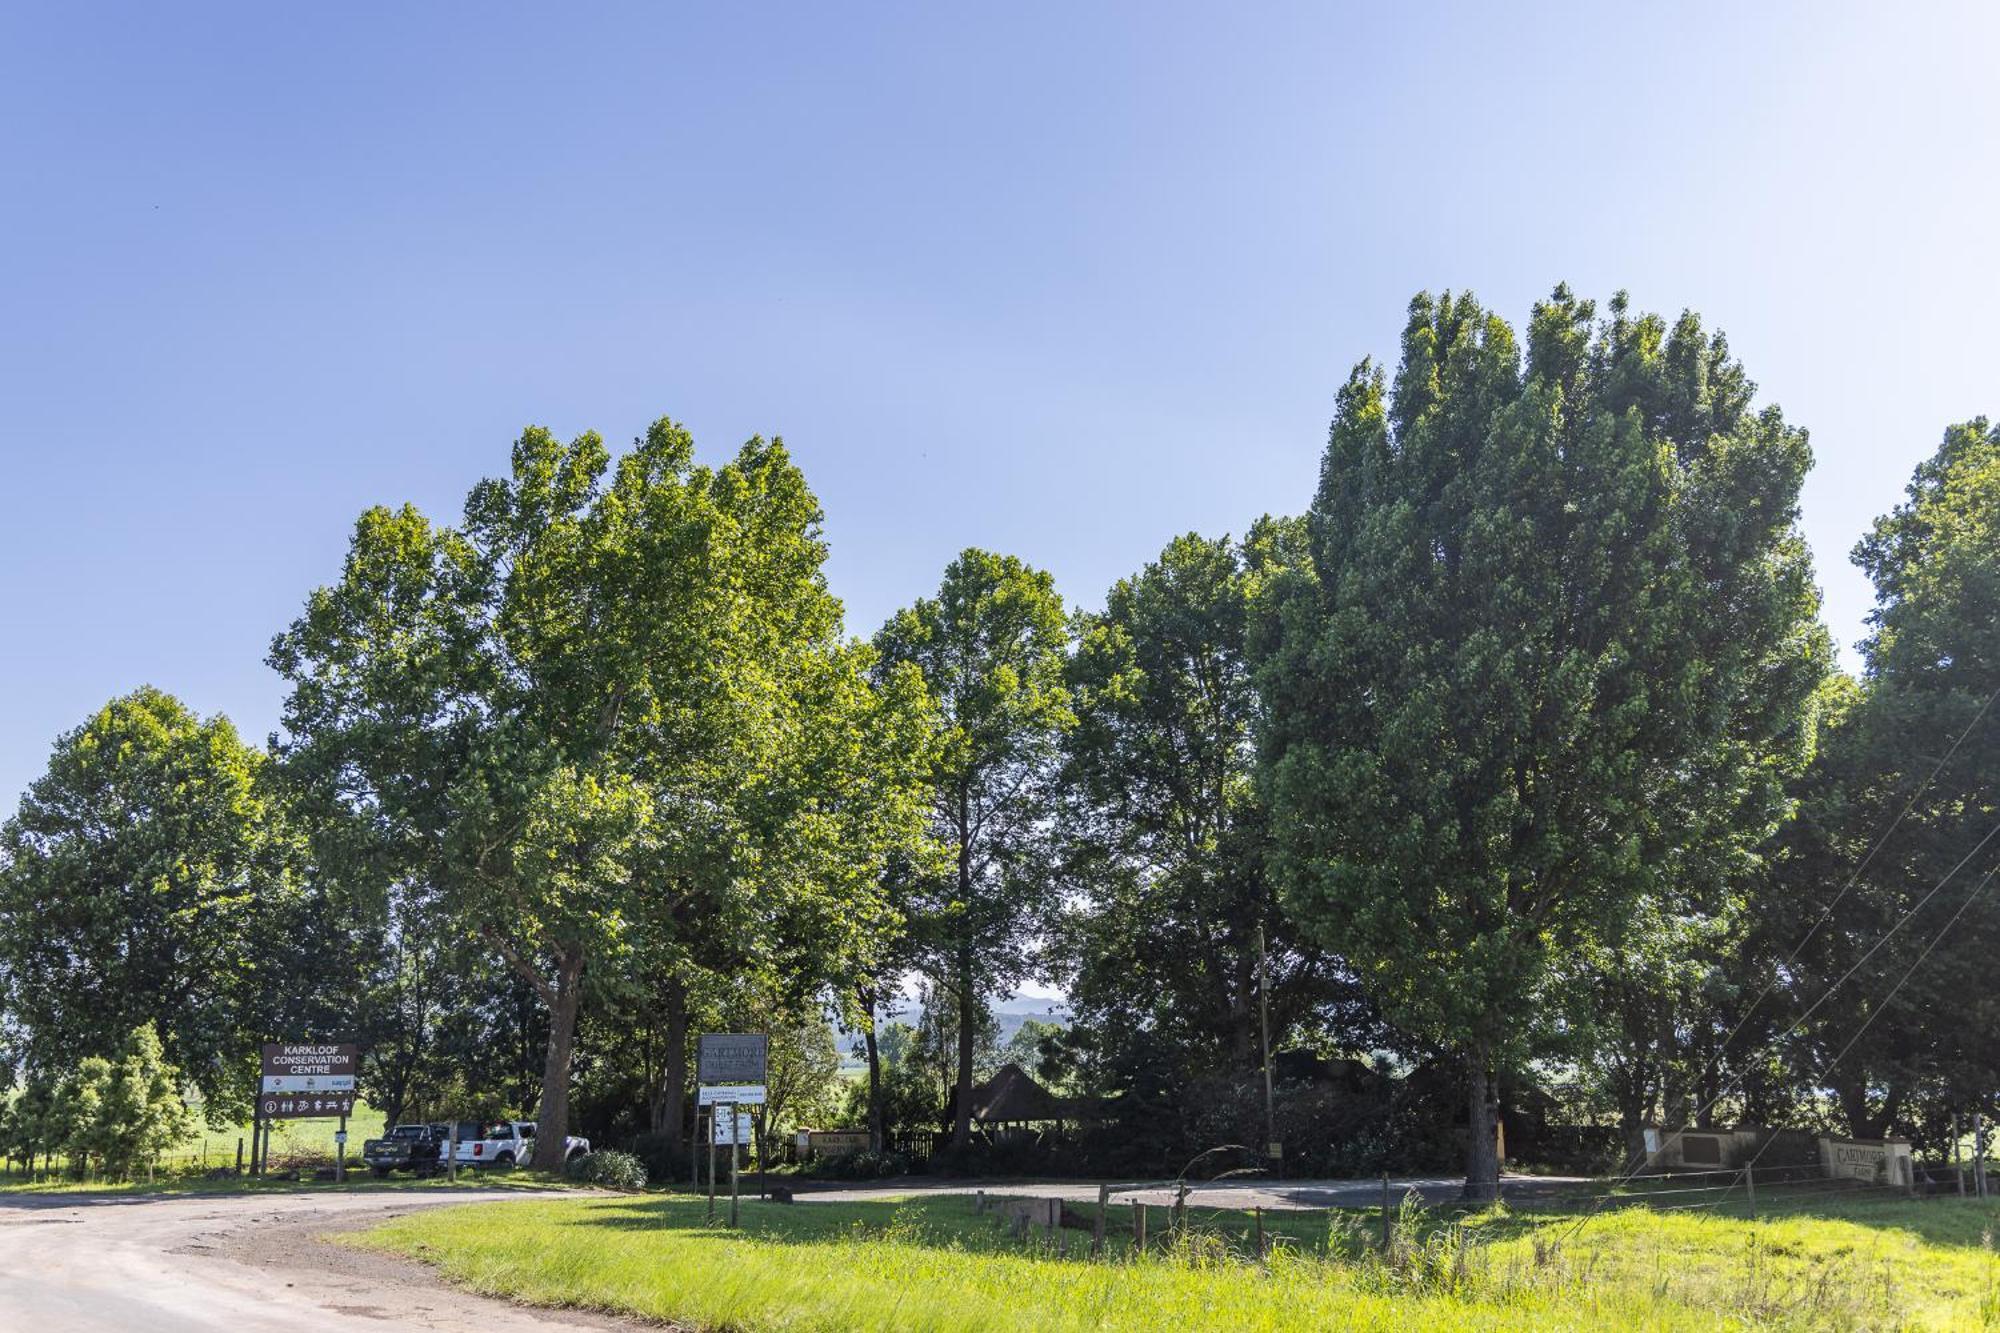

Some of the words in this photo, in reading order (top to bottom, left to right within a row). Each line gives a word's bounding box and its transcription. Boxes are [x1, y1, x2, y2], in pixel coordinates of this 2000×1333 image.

[284, 1045, 339, 1055] KARKLOOF
[272, 1055, 349, 1065] CONSERVATION
[290, 1065, 331, 1074] CENTRE
